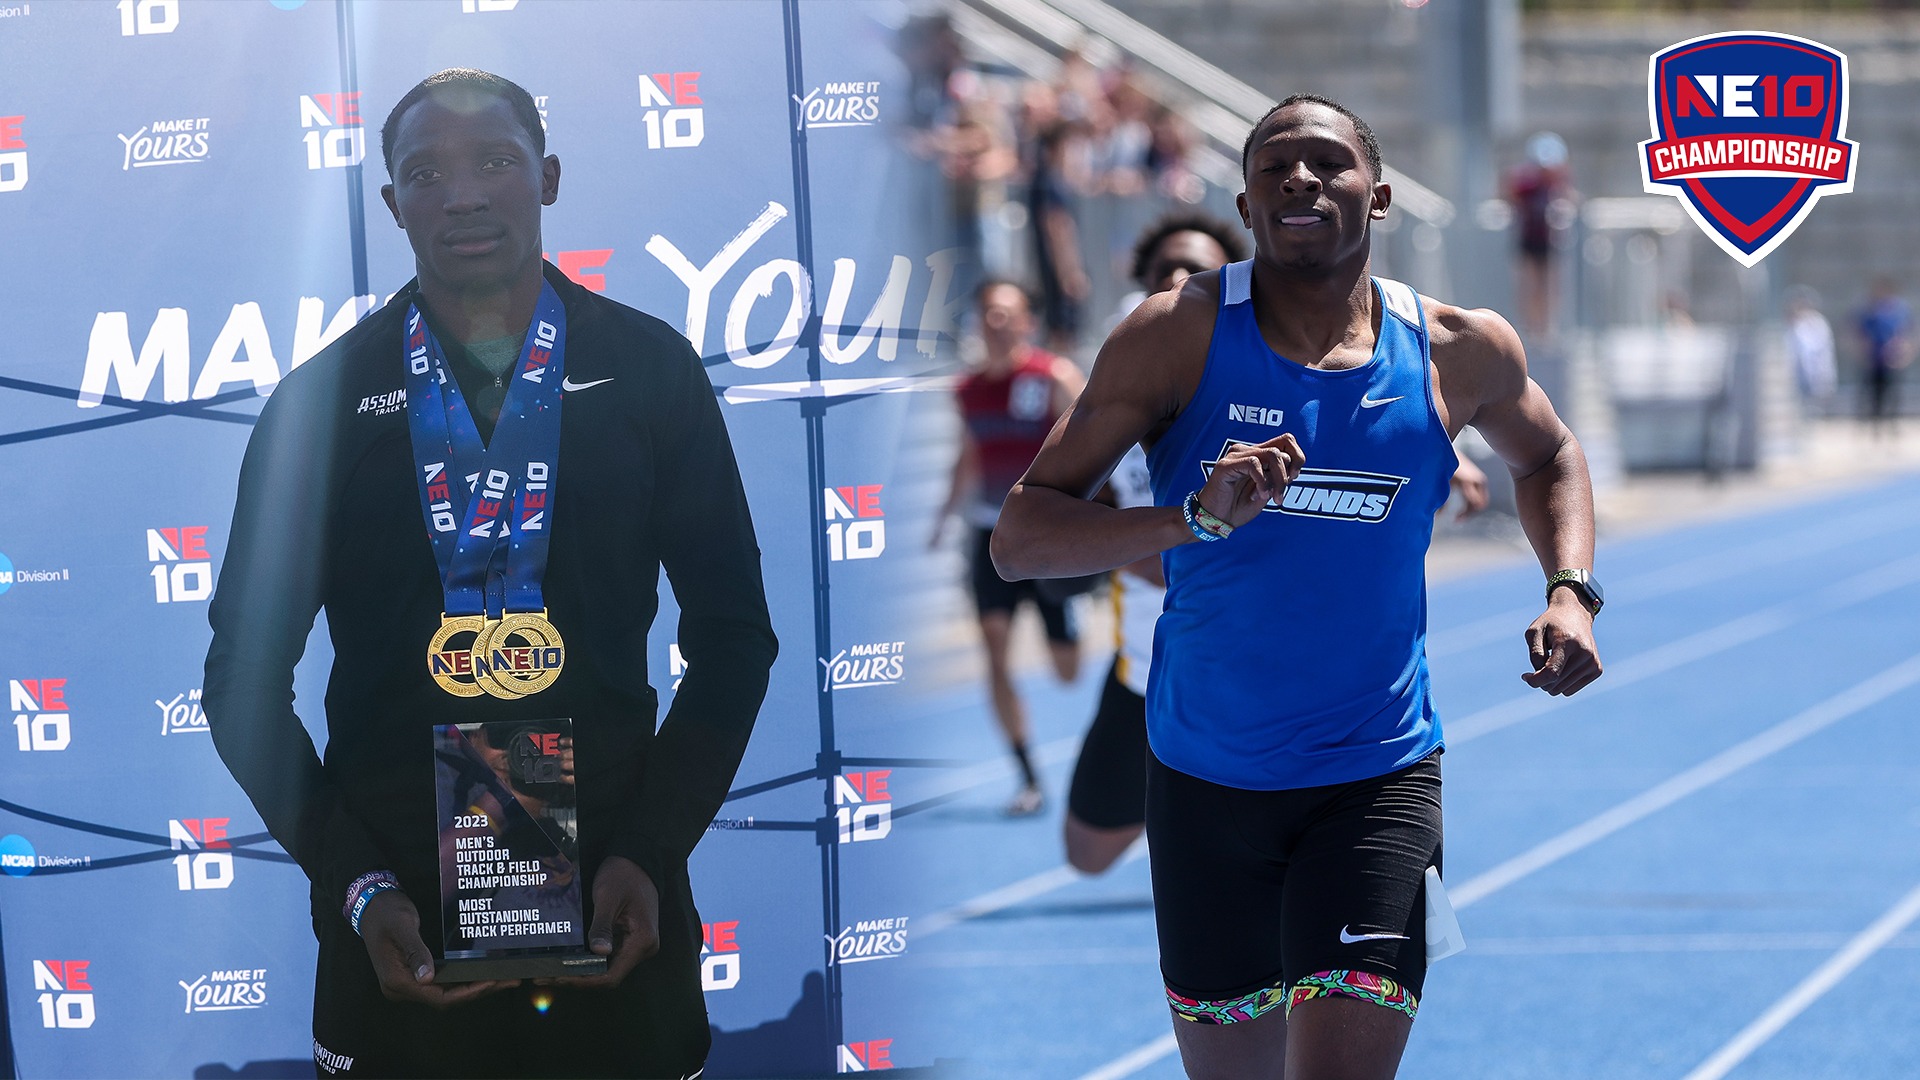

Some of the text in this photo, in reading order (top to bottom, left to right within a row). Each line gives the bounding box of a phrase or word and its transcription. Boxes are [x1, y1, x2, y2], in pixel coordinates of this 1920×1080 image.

[116, 0, 180, 36] 10
[638, 71, 703, 107] NE
[825, 81, 880, 95] MAKE IT
[152, 117, 210, 133] MAKE IT
[299, 91, 365, 127] NE
[0, 115, 28, 149] E
[641, 108, 705, 150] 10
[302, 127, 366, 170] 10
[0, 151, 29, 192] 0
[77, 292, 398, 408] MAK
[409, 311, 430, 376] NE10
[522, 319, 557, 384] NE10
[374, 404, 400, 416] TRACK
[1228, 403, 1284, 427] NE10
[423, 462, 457, 532] NE10
[469, 469, 510, 538] NE10
[521, 461, 549, 530] NE10
[824, 484, 885, 520] NE
[1269, 485, 1389, 517] UNDS
[147, 525, 212, 561] NE
[826, 520, 886, 561] 10
[17, 570, 61, 583] Division
[63, 568, 69, 580] II
[150, 562, 213, 603] 10
[432, 651, 472, 675] NE
[493, 647, 562, 671] NE10
[851, 641, 905, 657] MAKE IT
[10, 678, 70, 711] NE
[13, 713, 72, 751] 10
[834, 770, 893, 805] NE
[169, 817, 232, 850] NE
[454, 814, 489, 829] 2023
[834, 803, 892, 844] 10
[456, 836, 494, 850] MEN'S
[456, 848, 510, 863] OUTDOOR
[1, 854, 36, 868] NCAA
[38, 855, 82, 867] Division
[172, 852, 235, 891] 10
[457, 860, 540, 876] TRACK & FIELD
[458, 873, 547, 890] CHAMPIONSHIP
[459, 898, 493, 912] MOST
[459, 909, 540, 925] OUTSTANDING
[460, 921, 572, 939] TRACK PERFORMER
[855, 916, 909, 933] MAKE IT
[33, 959, 94, 991] NE
[211, 968, 267, 982] MAKE IT
[701, 953, 740, 991] 0
[37, 993, 96, 1029] 10
[837, 1038, 894, 1074] NE
